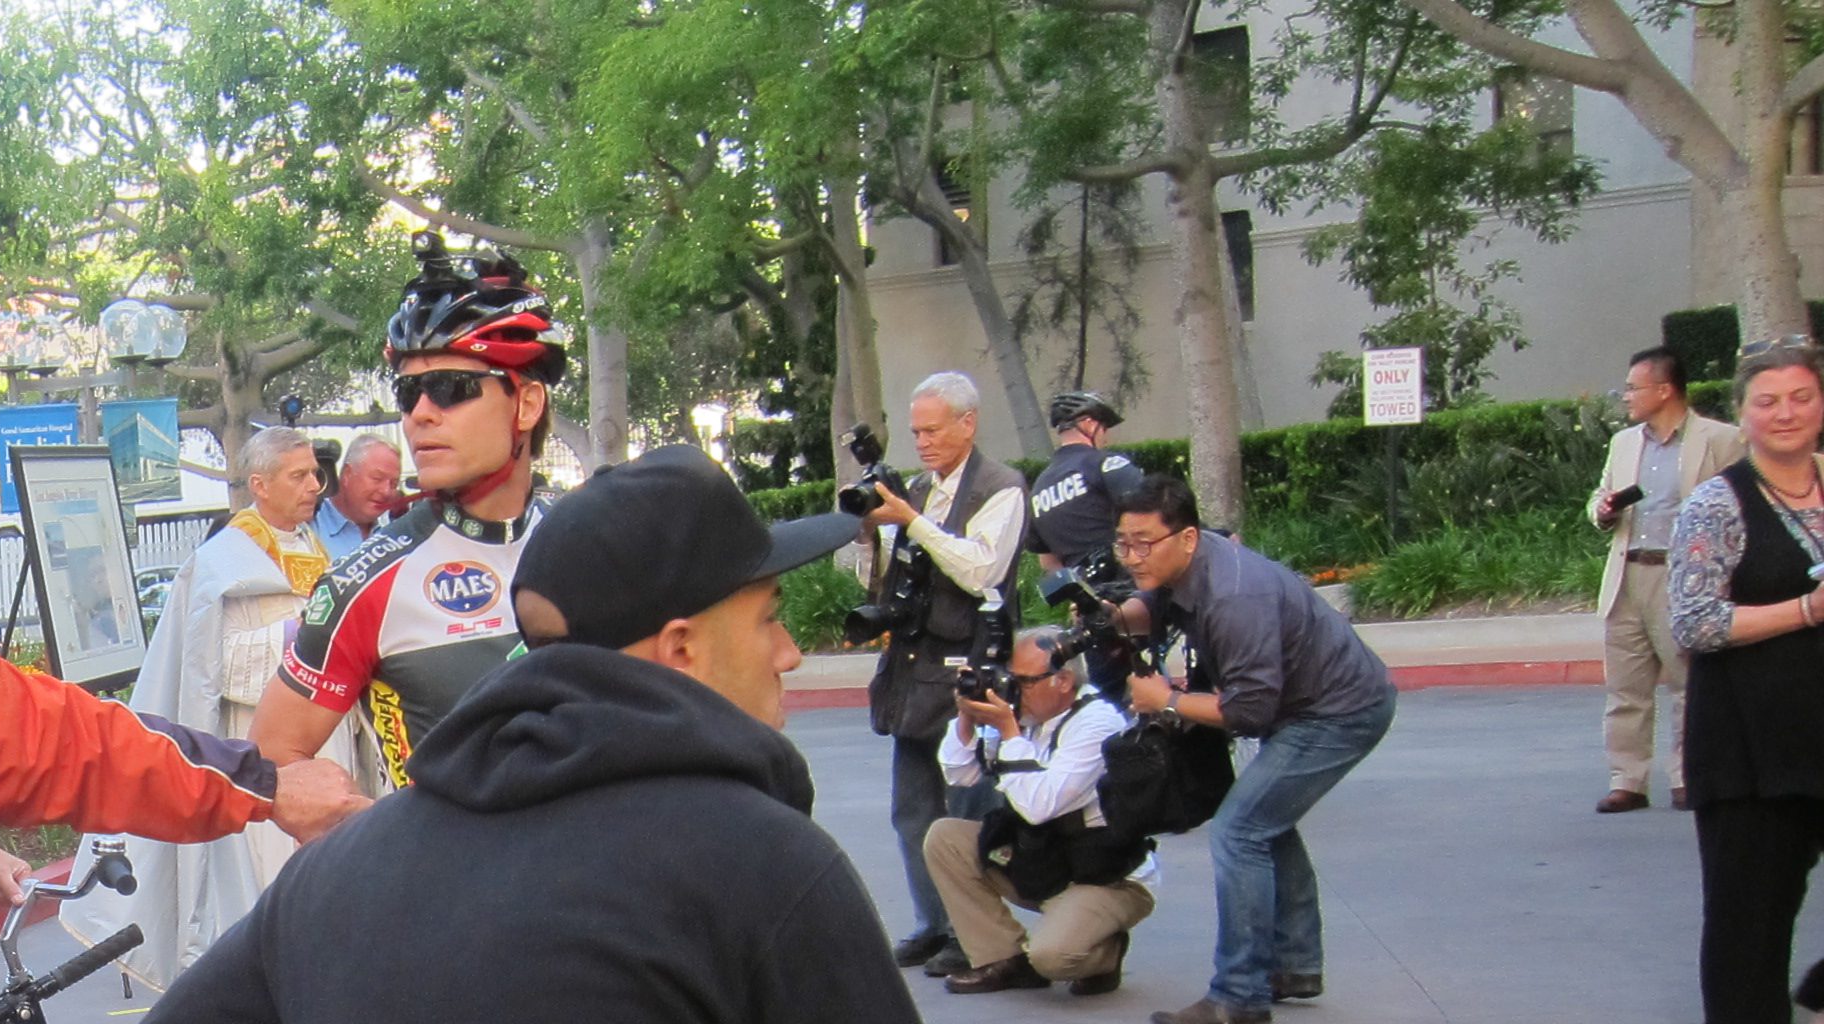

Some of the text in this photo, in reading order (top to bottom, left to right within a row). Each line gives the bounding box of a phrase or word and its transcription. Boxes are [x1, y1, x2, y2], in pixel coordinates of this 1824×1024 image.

[1374, 369, 1409, 384] ONLY
[1369, 402, 1416, 417] TOWED
[1031, 473, 1088, 518] POLICE
[331, 532, 413, 595] Agricole
[429, 571, 497, 603] MAES
